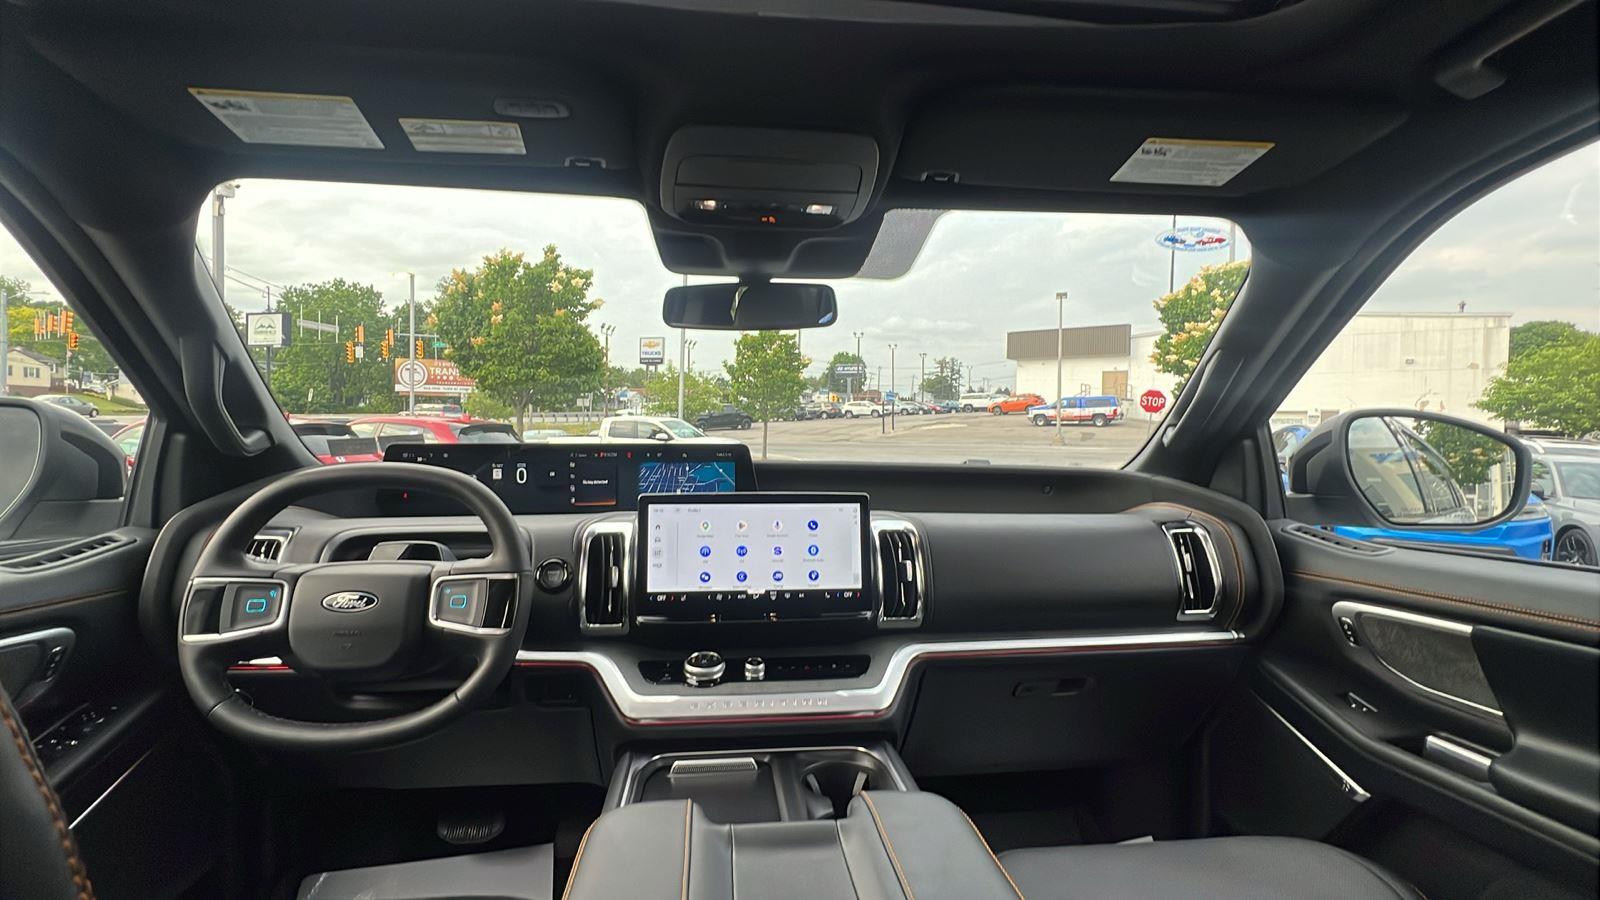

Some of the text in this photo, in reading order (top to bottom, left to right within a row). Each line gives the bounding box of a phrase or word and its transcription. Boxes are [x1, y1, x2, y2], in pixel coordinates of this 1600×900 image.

[1141, 395, 1165, 407] STOP
[516, 467, 527, 484] 0
[332, 594, 368, 608] Ford
